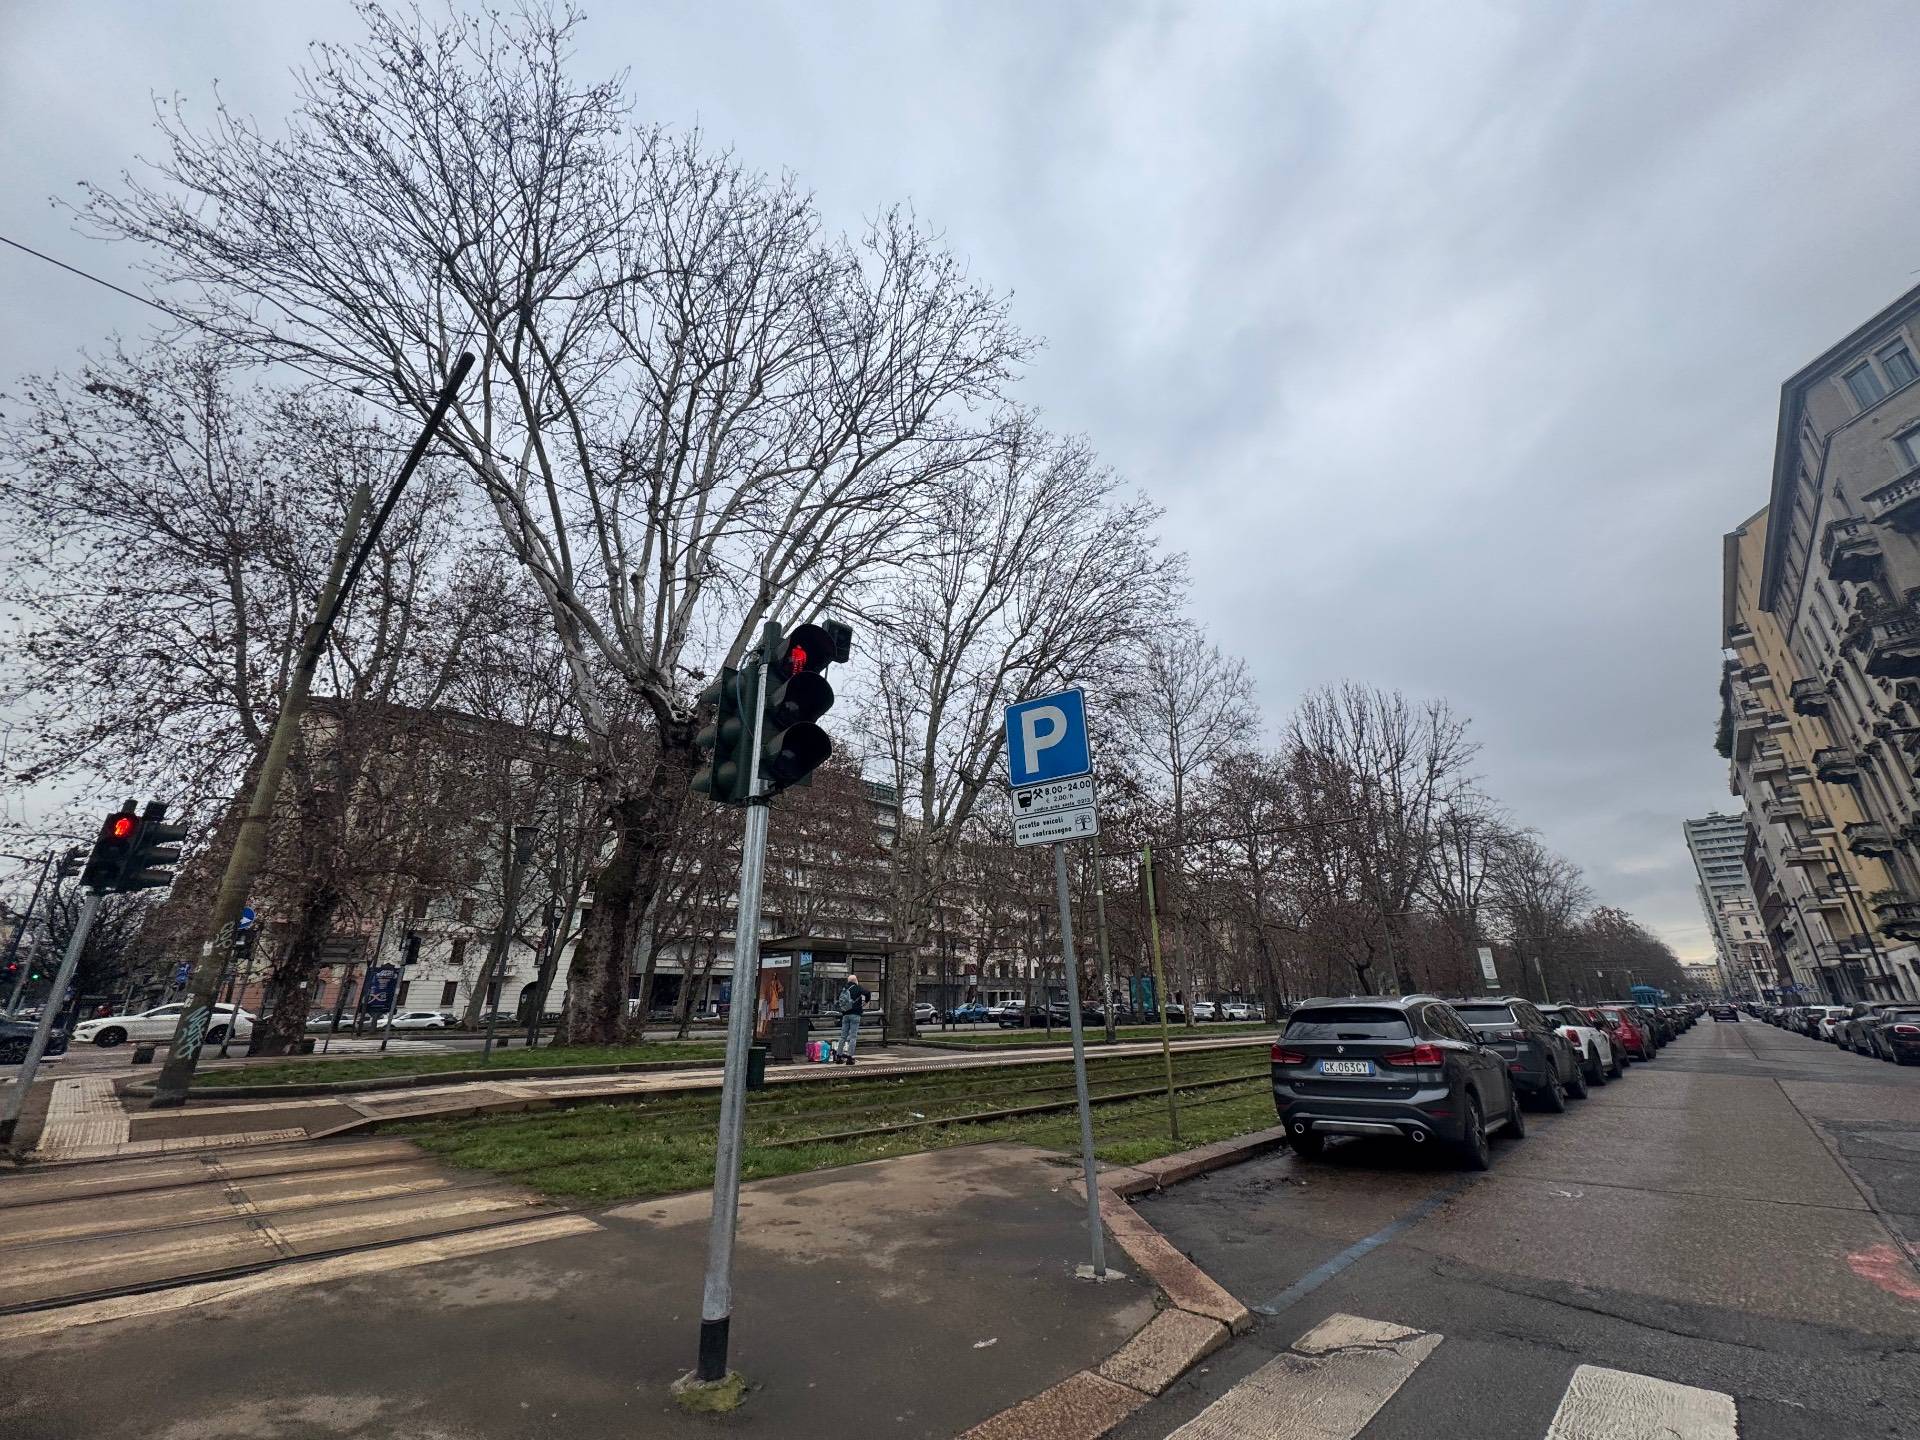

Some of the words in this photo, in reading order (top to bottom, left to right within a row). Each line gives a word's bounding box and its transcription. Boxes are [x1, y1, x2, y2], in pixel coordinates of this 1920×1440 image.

[1021, 705, 1068, 774] P
[1018, 820, 1040, 830] eccetto
[1042, 815, 1064, 826] veicoli
[1019, 832, 1030, 840] con
[1032, 826, 1072, 838] contrassegno
